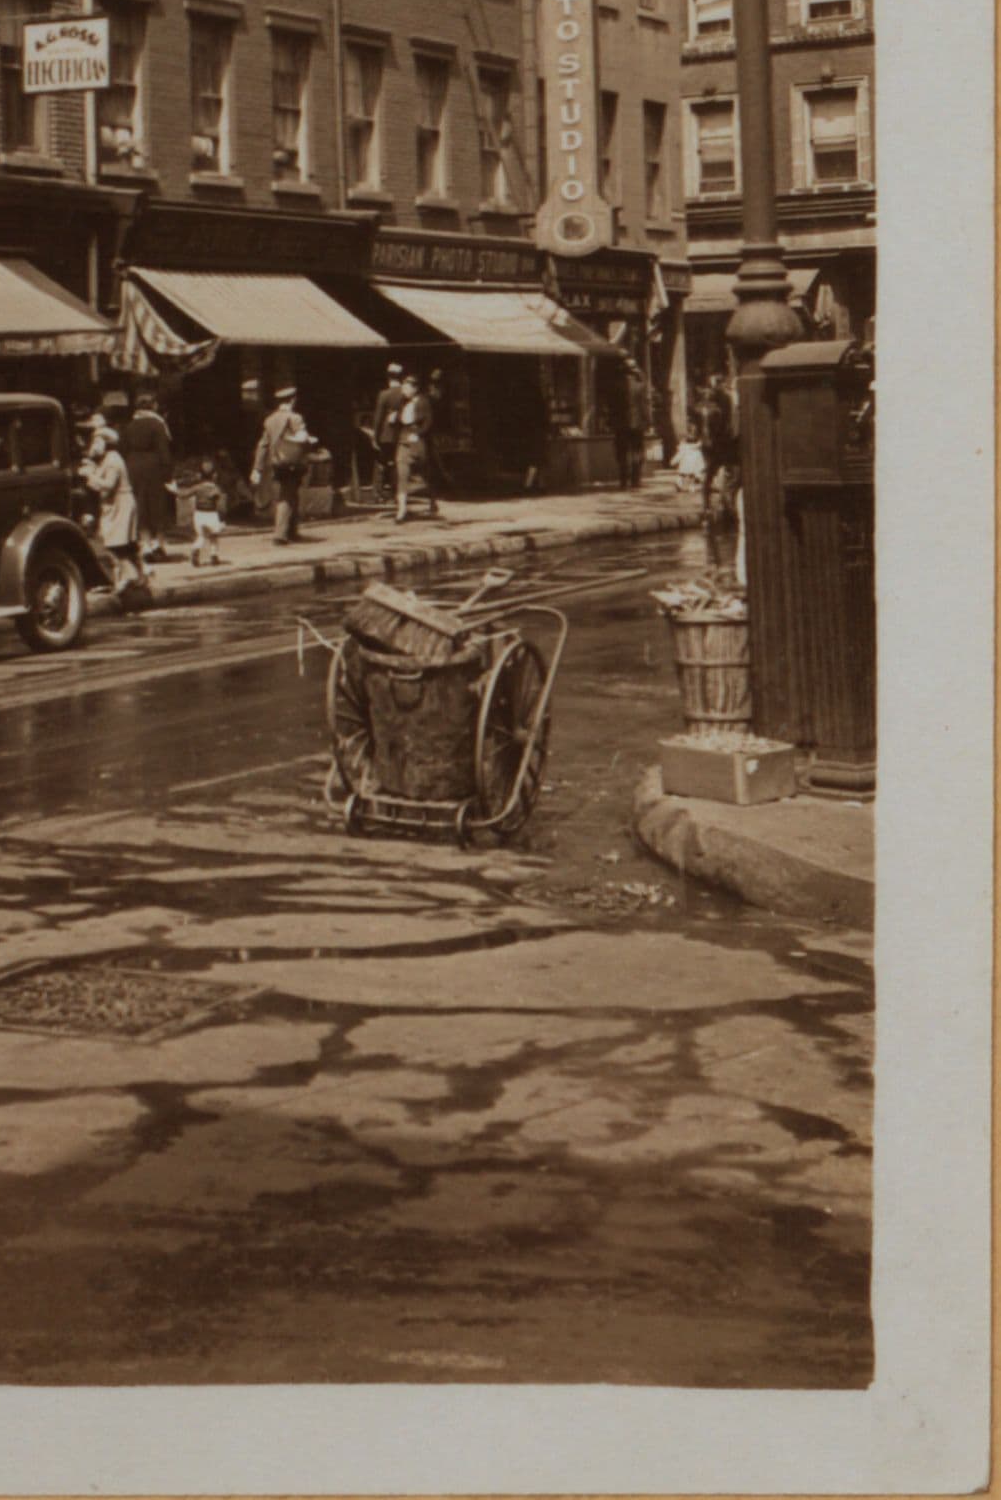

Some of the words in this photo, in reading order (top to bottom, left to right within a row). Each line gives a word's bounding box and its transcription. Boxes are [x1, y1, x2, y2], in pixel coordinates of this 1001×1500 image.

[557, 53, 585, 201] STUDIO
[370, 242, 426, 269] PARISIAN
[431, 246, 474, 274] PHOTO
[477, 249, 520, 276] STUDIO
